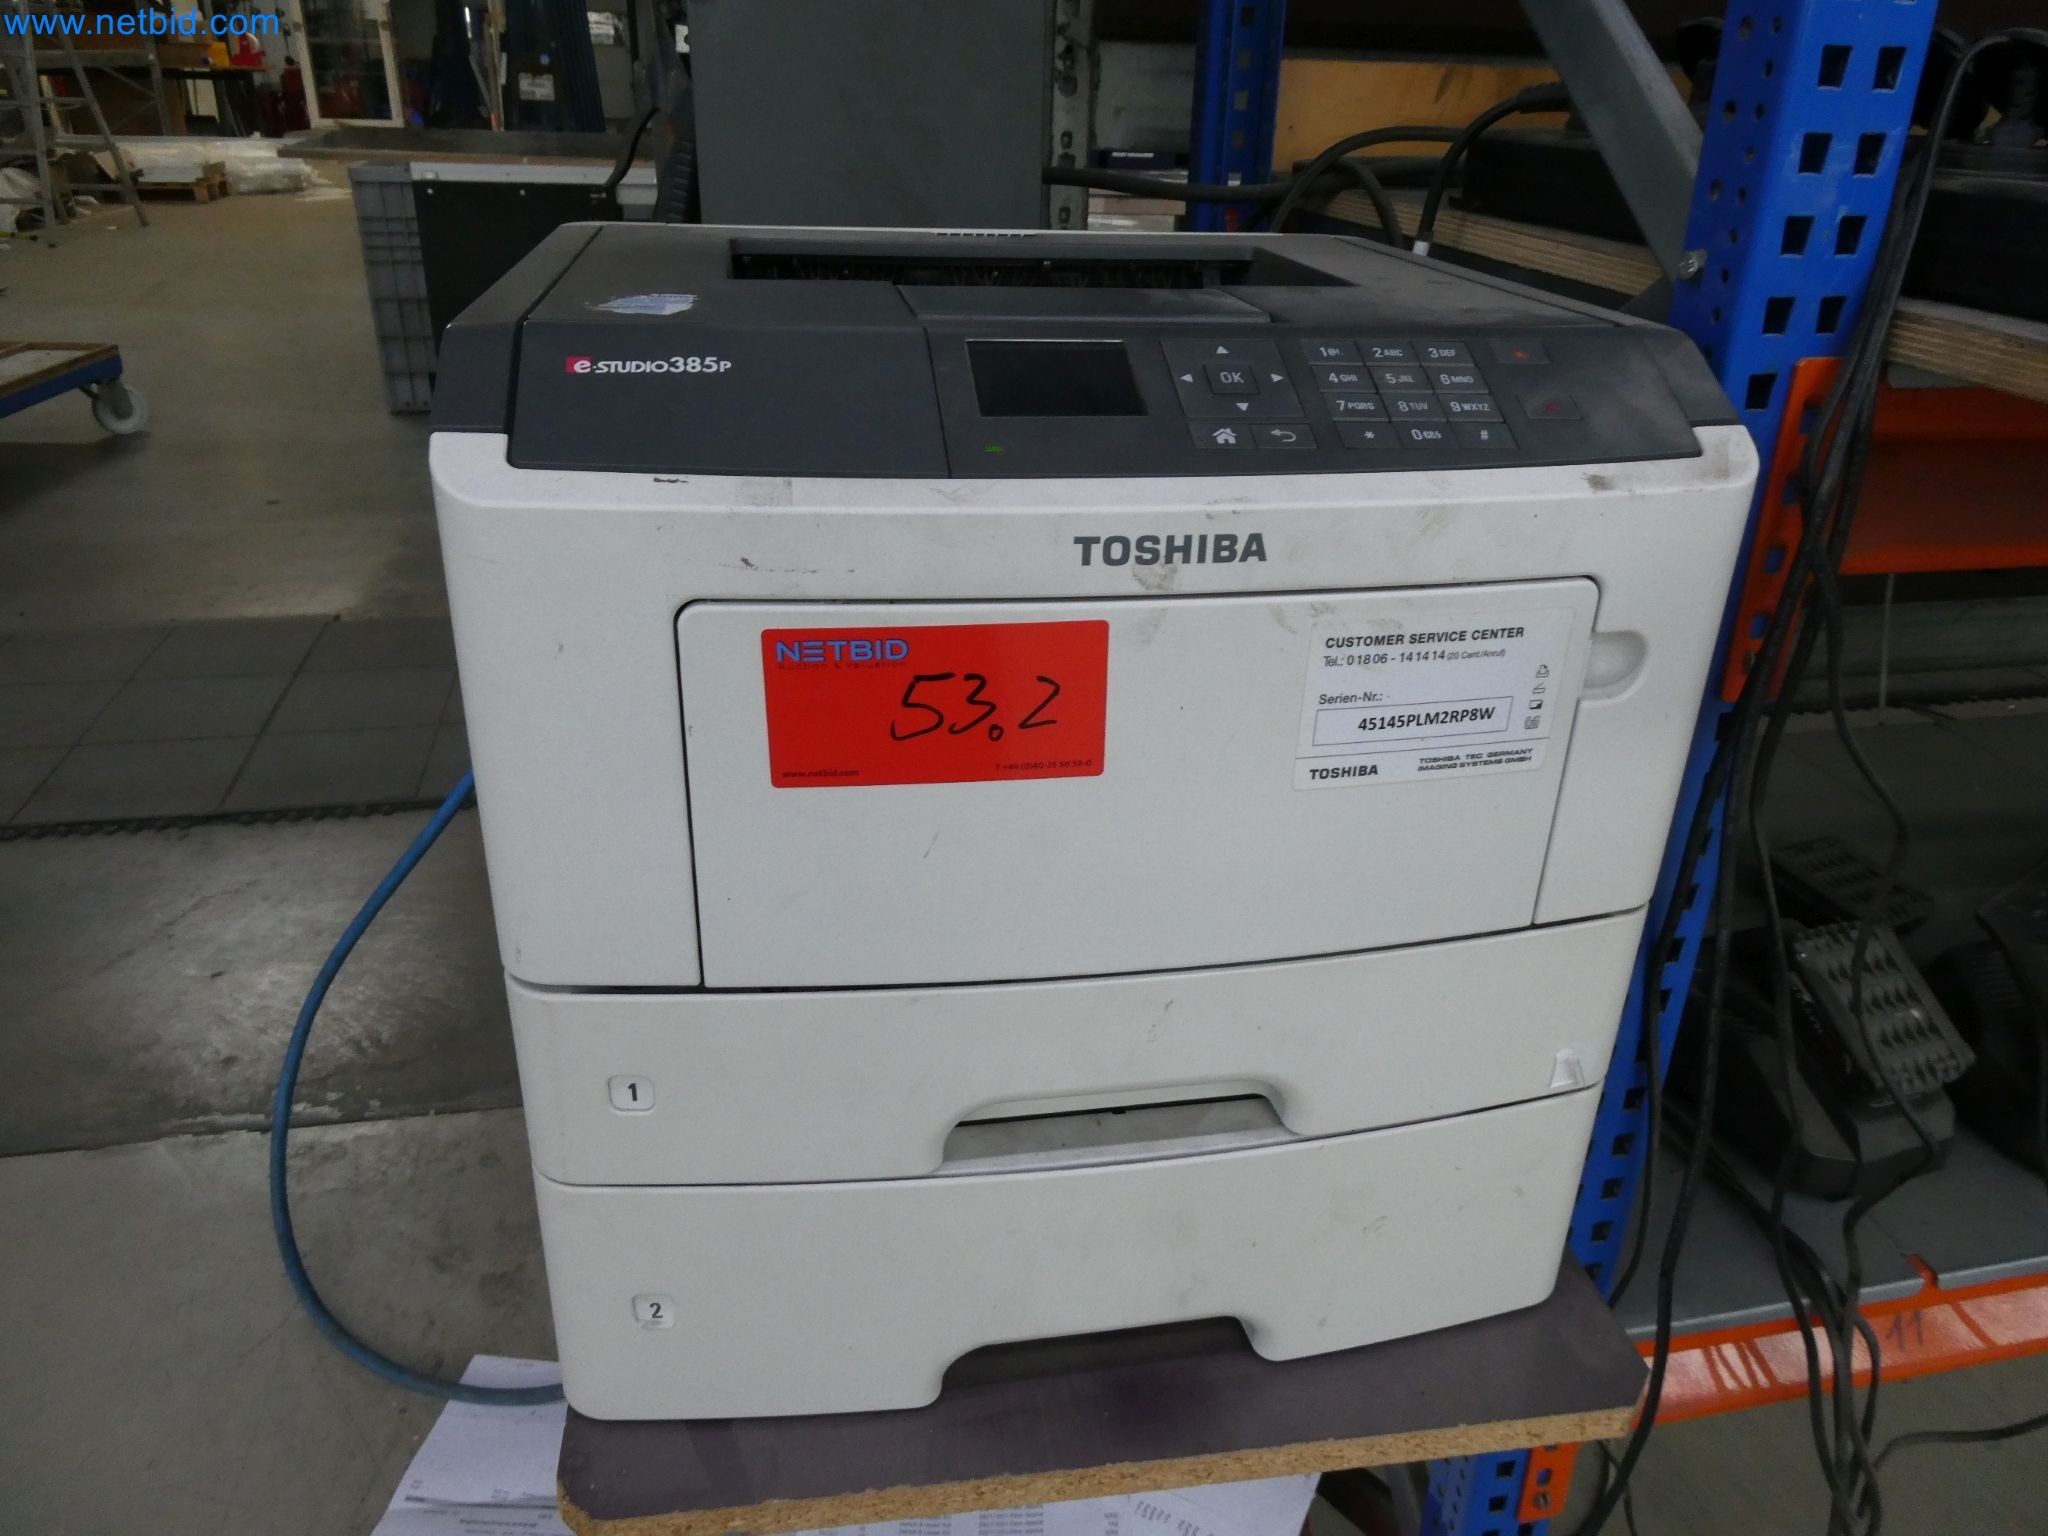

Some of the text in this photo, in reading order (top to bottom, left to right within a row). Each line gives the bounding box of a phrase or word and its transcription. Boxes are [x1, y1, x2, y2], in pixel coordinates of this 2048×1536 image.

[1219, 371, 1245, 384] OK
[1073, 532, 1267, 567] TOSHIBA
[1325, 626, 1525, 649] CUSTOMER SERVICE CENTER
[775, 638, 909, 663] NETBID
[1323, 654, 1344, 667] Tel.:
[890, 672, 1061, 742] 53.2
[1318, 692, 1384, 705] Serien-Nr.:
[1357, 706, 1496, 732] 45145PLM2RP8W
[1417, 762, 1458, 772] IMAGING
[1459, 757, 1503, 769] SYSTEMS
[1419, 747, 1534, 764] TOSHIBA TEC GERMANY
[781, 768, 860, 779] www.netbid.com
[1309, 764, 1379, 780] TOSHIBA
[627, 1082, 638, 1102] 1
[648, 1301, 664, 1320] 2
